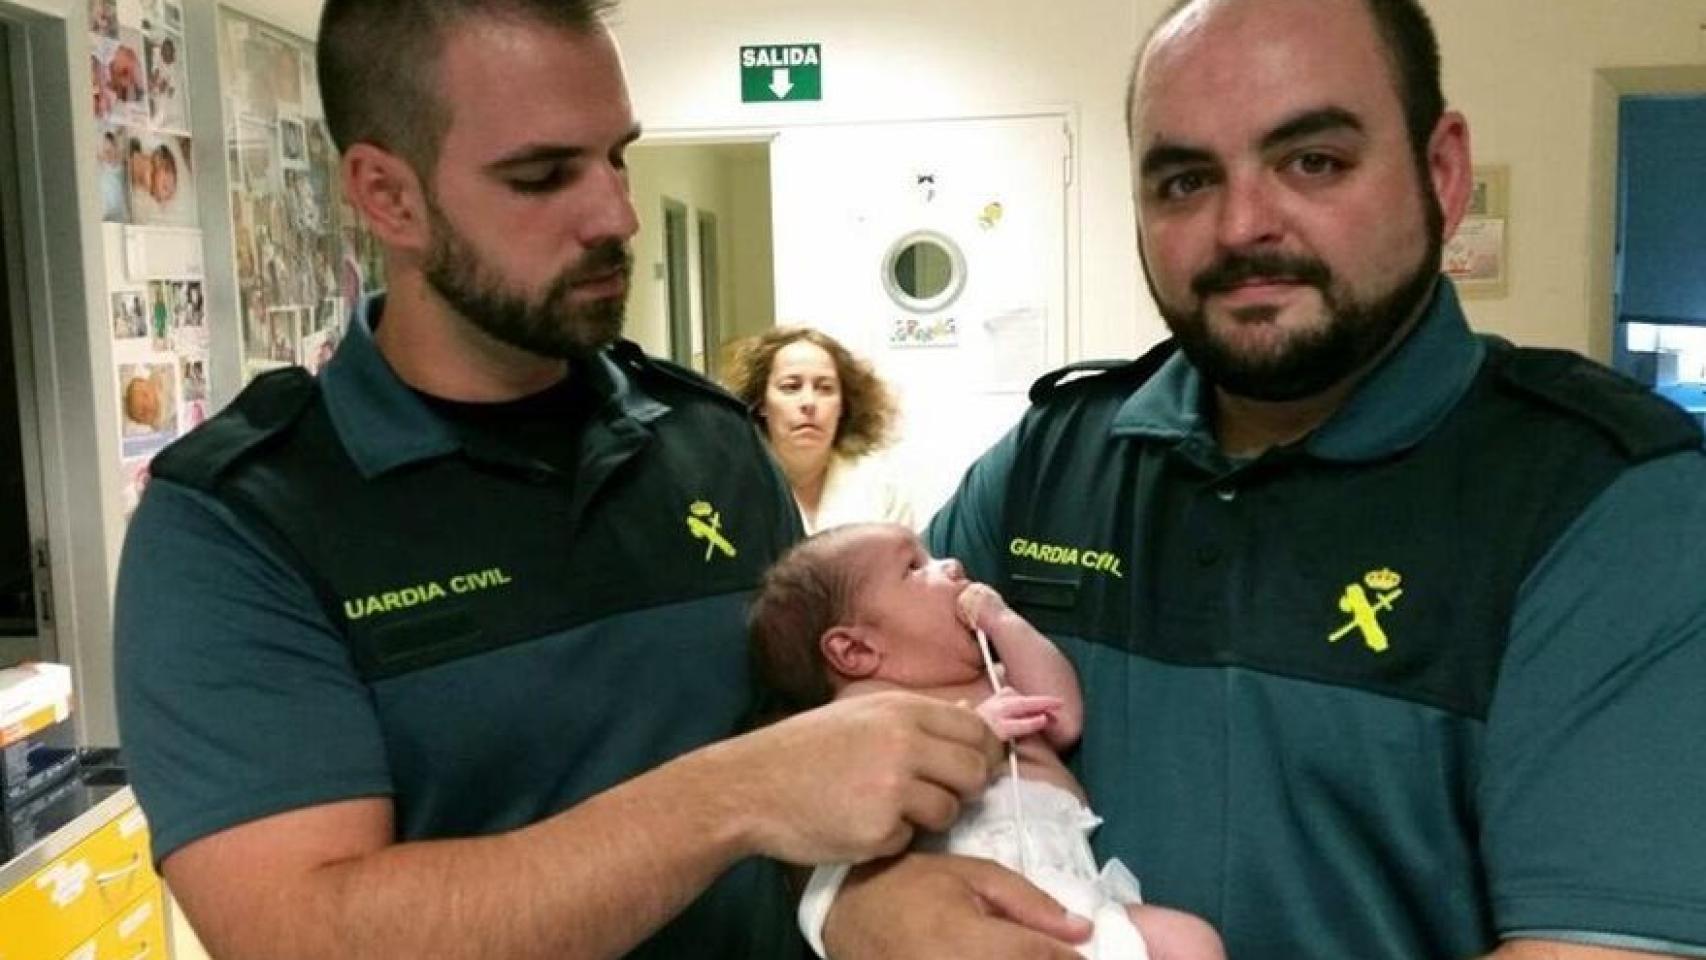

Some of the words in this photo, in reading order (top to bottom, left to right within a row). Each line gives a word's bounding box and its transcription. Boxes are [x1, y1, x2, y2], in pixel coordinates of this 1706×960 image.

[742, 46, 819, 67] SALIDA
[1010, 538, 1078, 565] GARDIA
[343, 581, 447, 620] UARDIA
[449, 567, 512, 593] CIVIL
